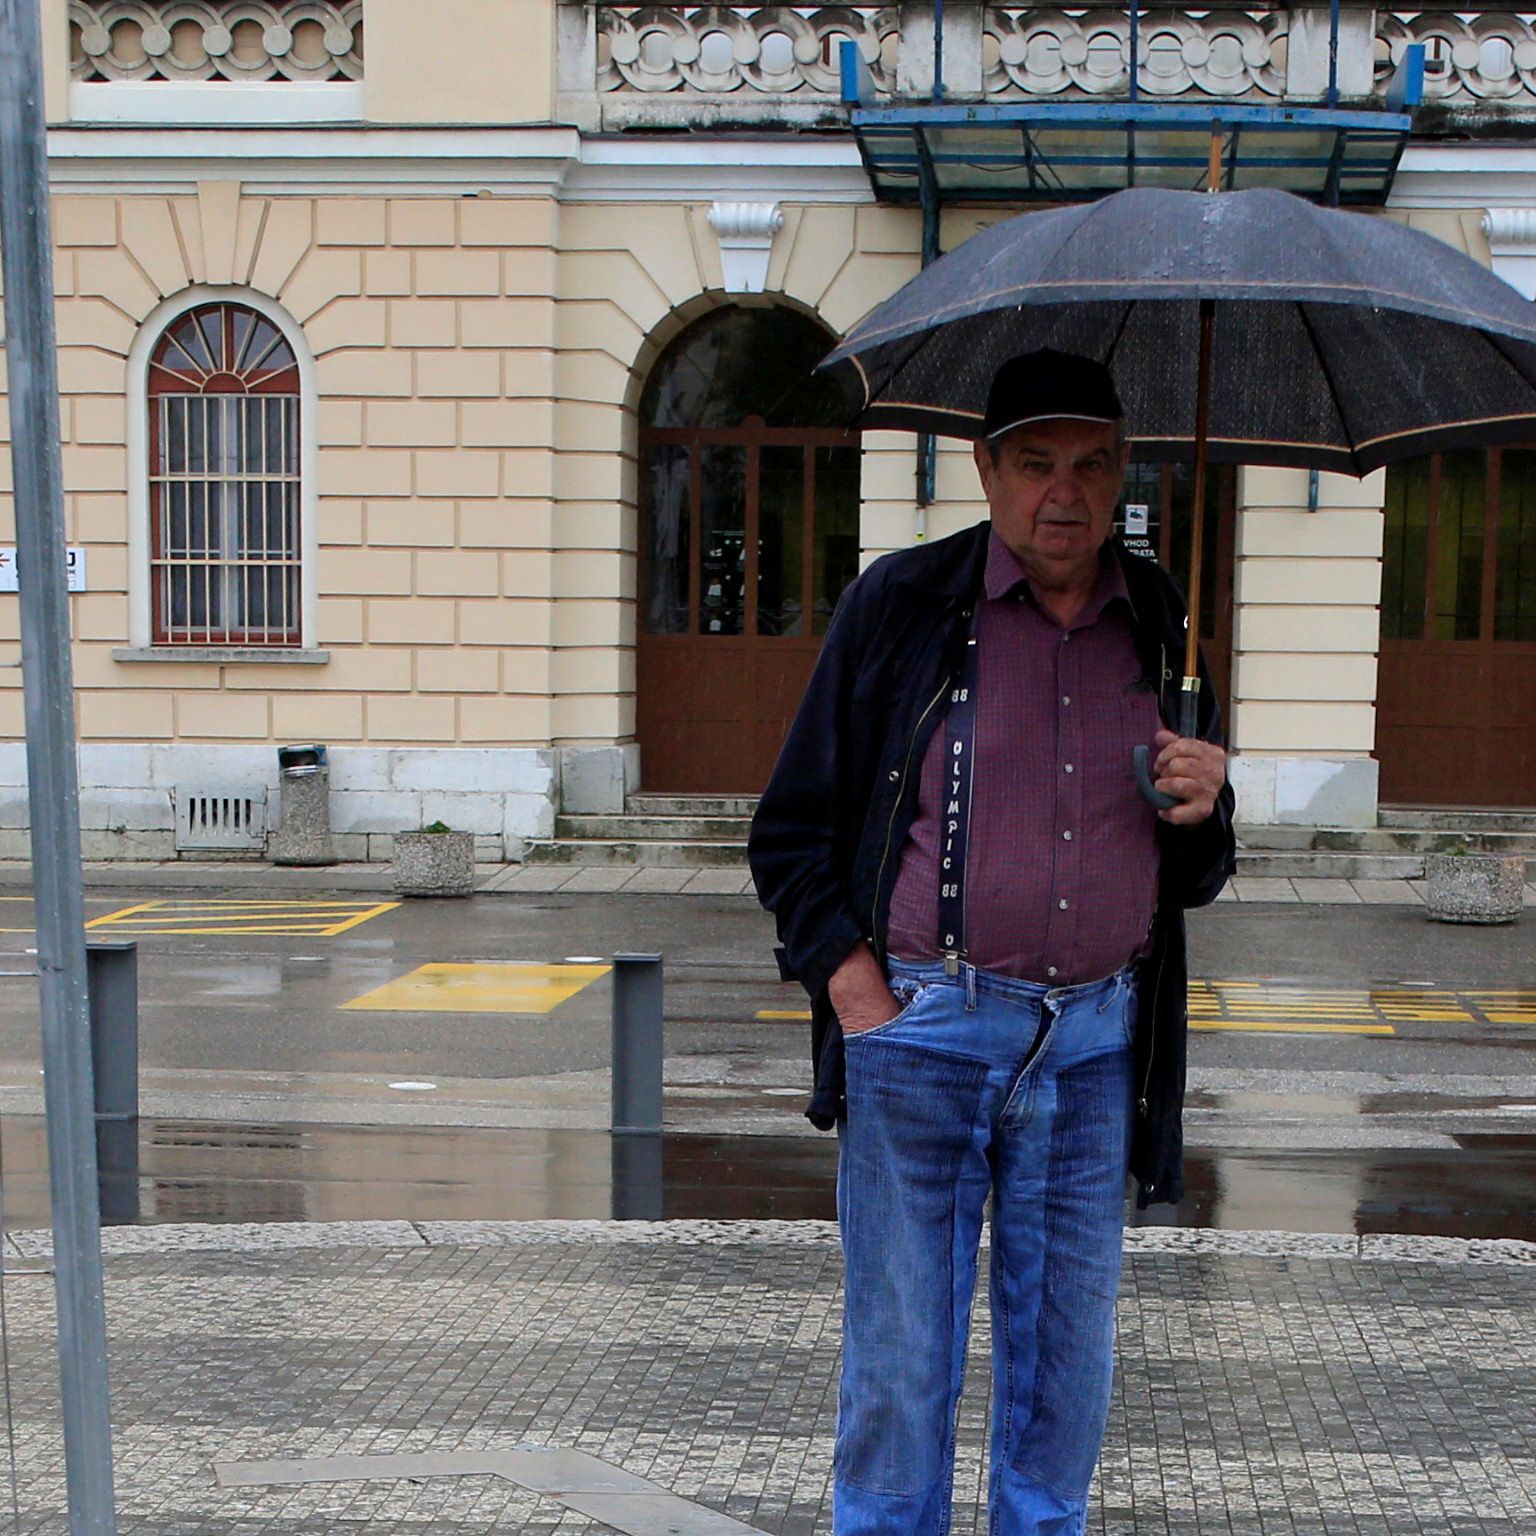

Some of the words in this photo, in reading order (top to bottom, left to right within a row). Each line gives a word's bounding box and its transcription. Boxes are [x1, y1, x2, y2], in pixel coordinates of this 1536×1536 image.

[1123, 539, 1150, 548] VHOD
[951, 688, 968, 703] 88
[943, 740, 963, 870] OLYMPIC
[941, 883, 958, 898] 88
